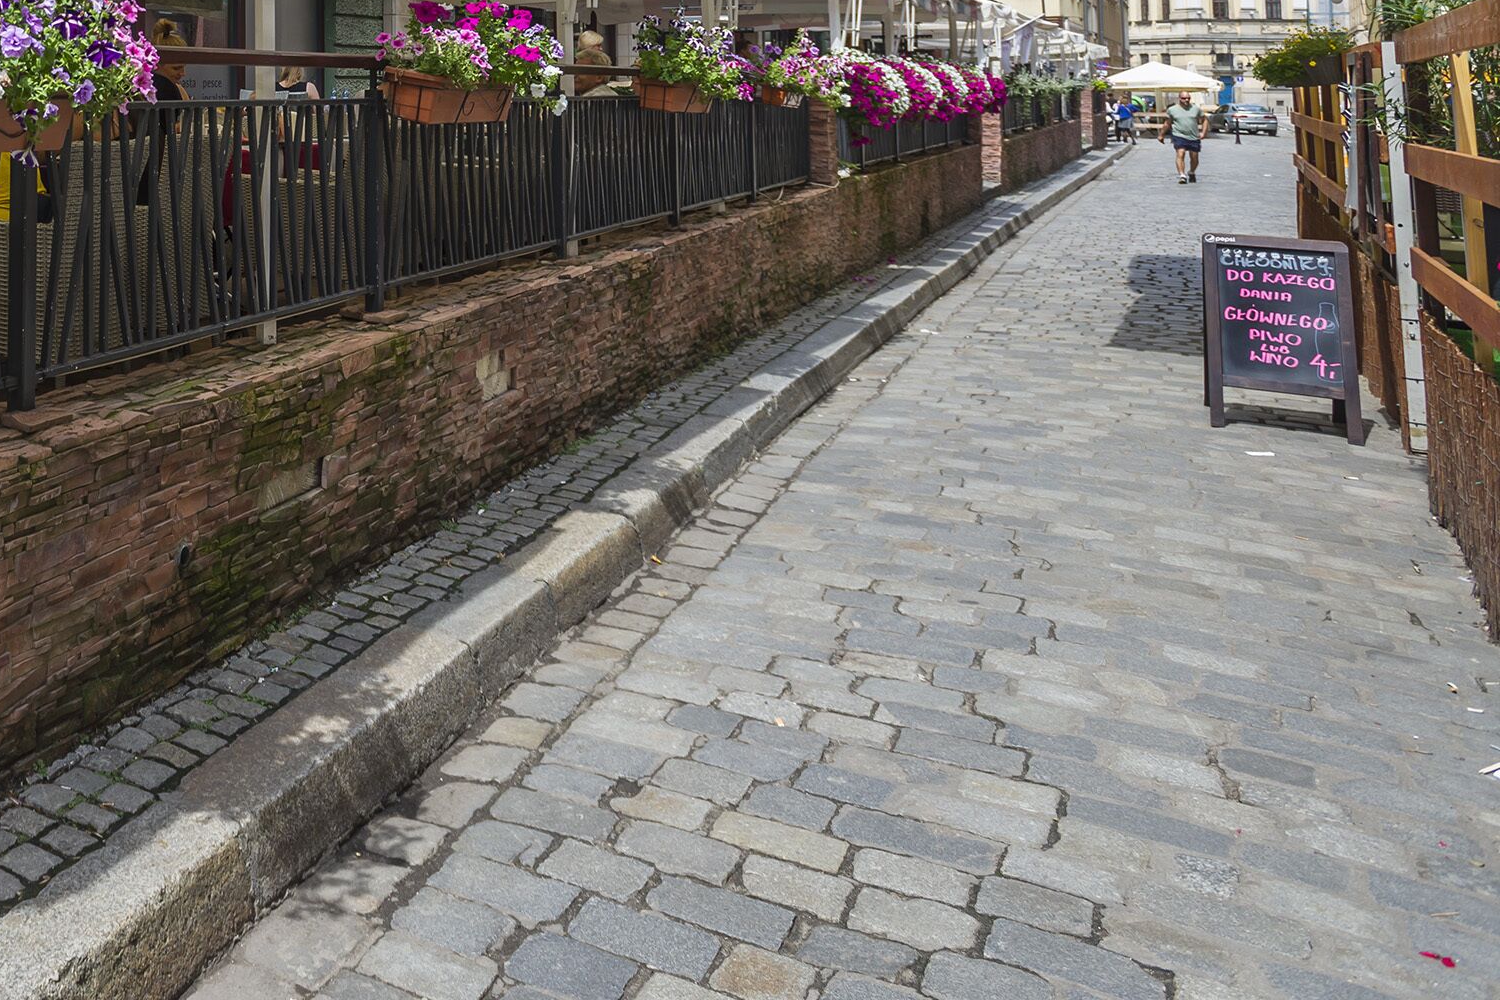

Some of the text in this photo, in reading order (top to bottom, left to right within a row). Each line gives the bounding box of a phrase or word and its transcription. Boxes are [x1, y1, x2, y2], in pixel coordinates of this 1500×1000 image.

[1226, 269, 1254, 282] DO
[1239, 288, 1292, 302] DANIA
[1249, 328, 1302, 346] PIWO
[1250, 351, 1299, 368] WINO
